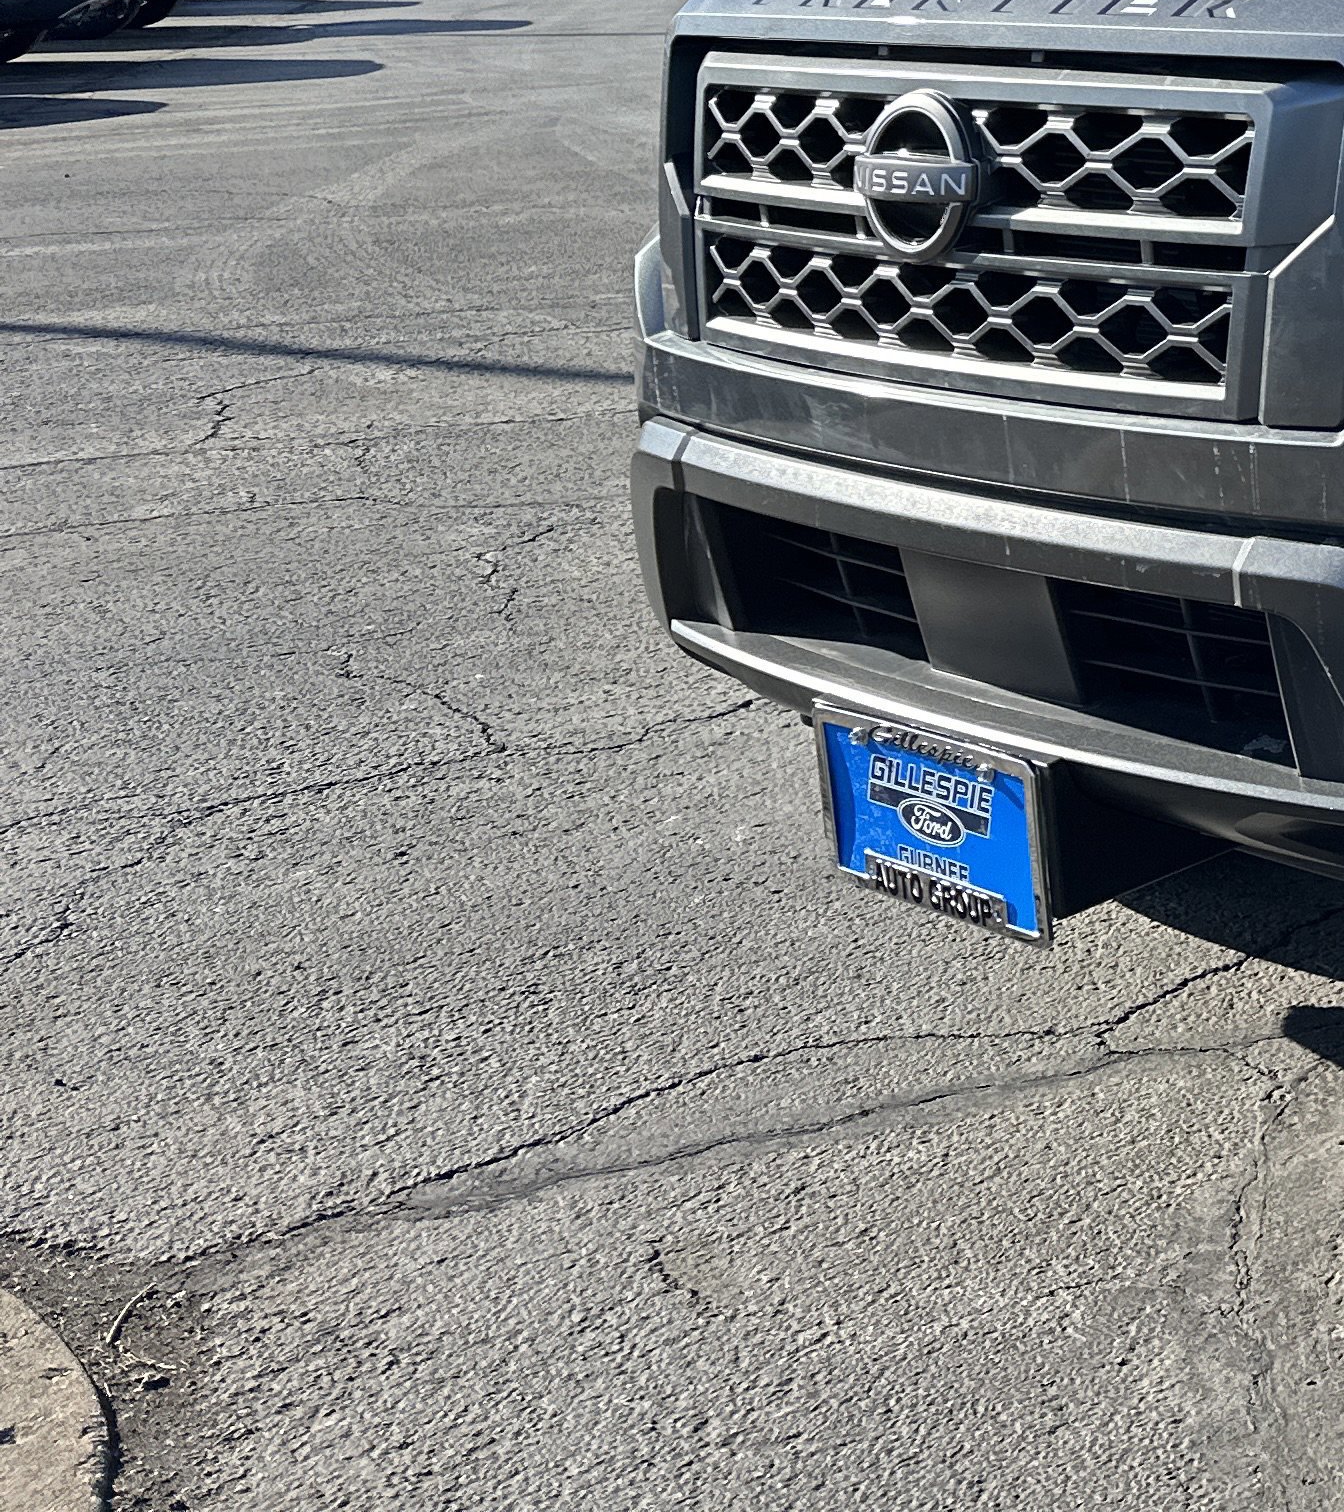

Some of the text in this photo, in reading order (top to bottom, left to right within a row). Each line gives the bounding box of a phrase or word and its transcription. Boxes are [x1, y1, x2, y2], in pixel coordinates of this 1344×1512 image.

[855, 165, 966, 196] NISSAN
[869, 725, 979, 769] Gillespie
[869, 754, 994, 817] GILLESPIE
[910, 805, 953, 841] Ford
[875, 859, 992, 927] AUTO GROUP
